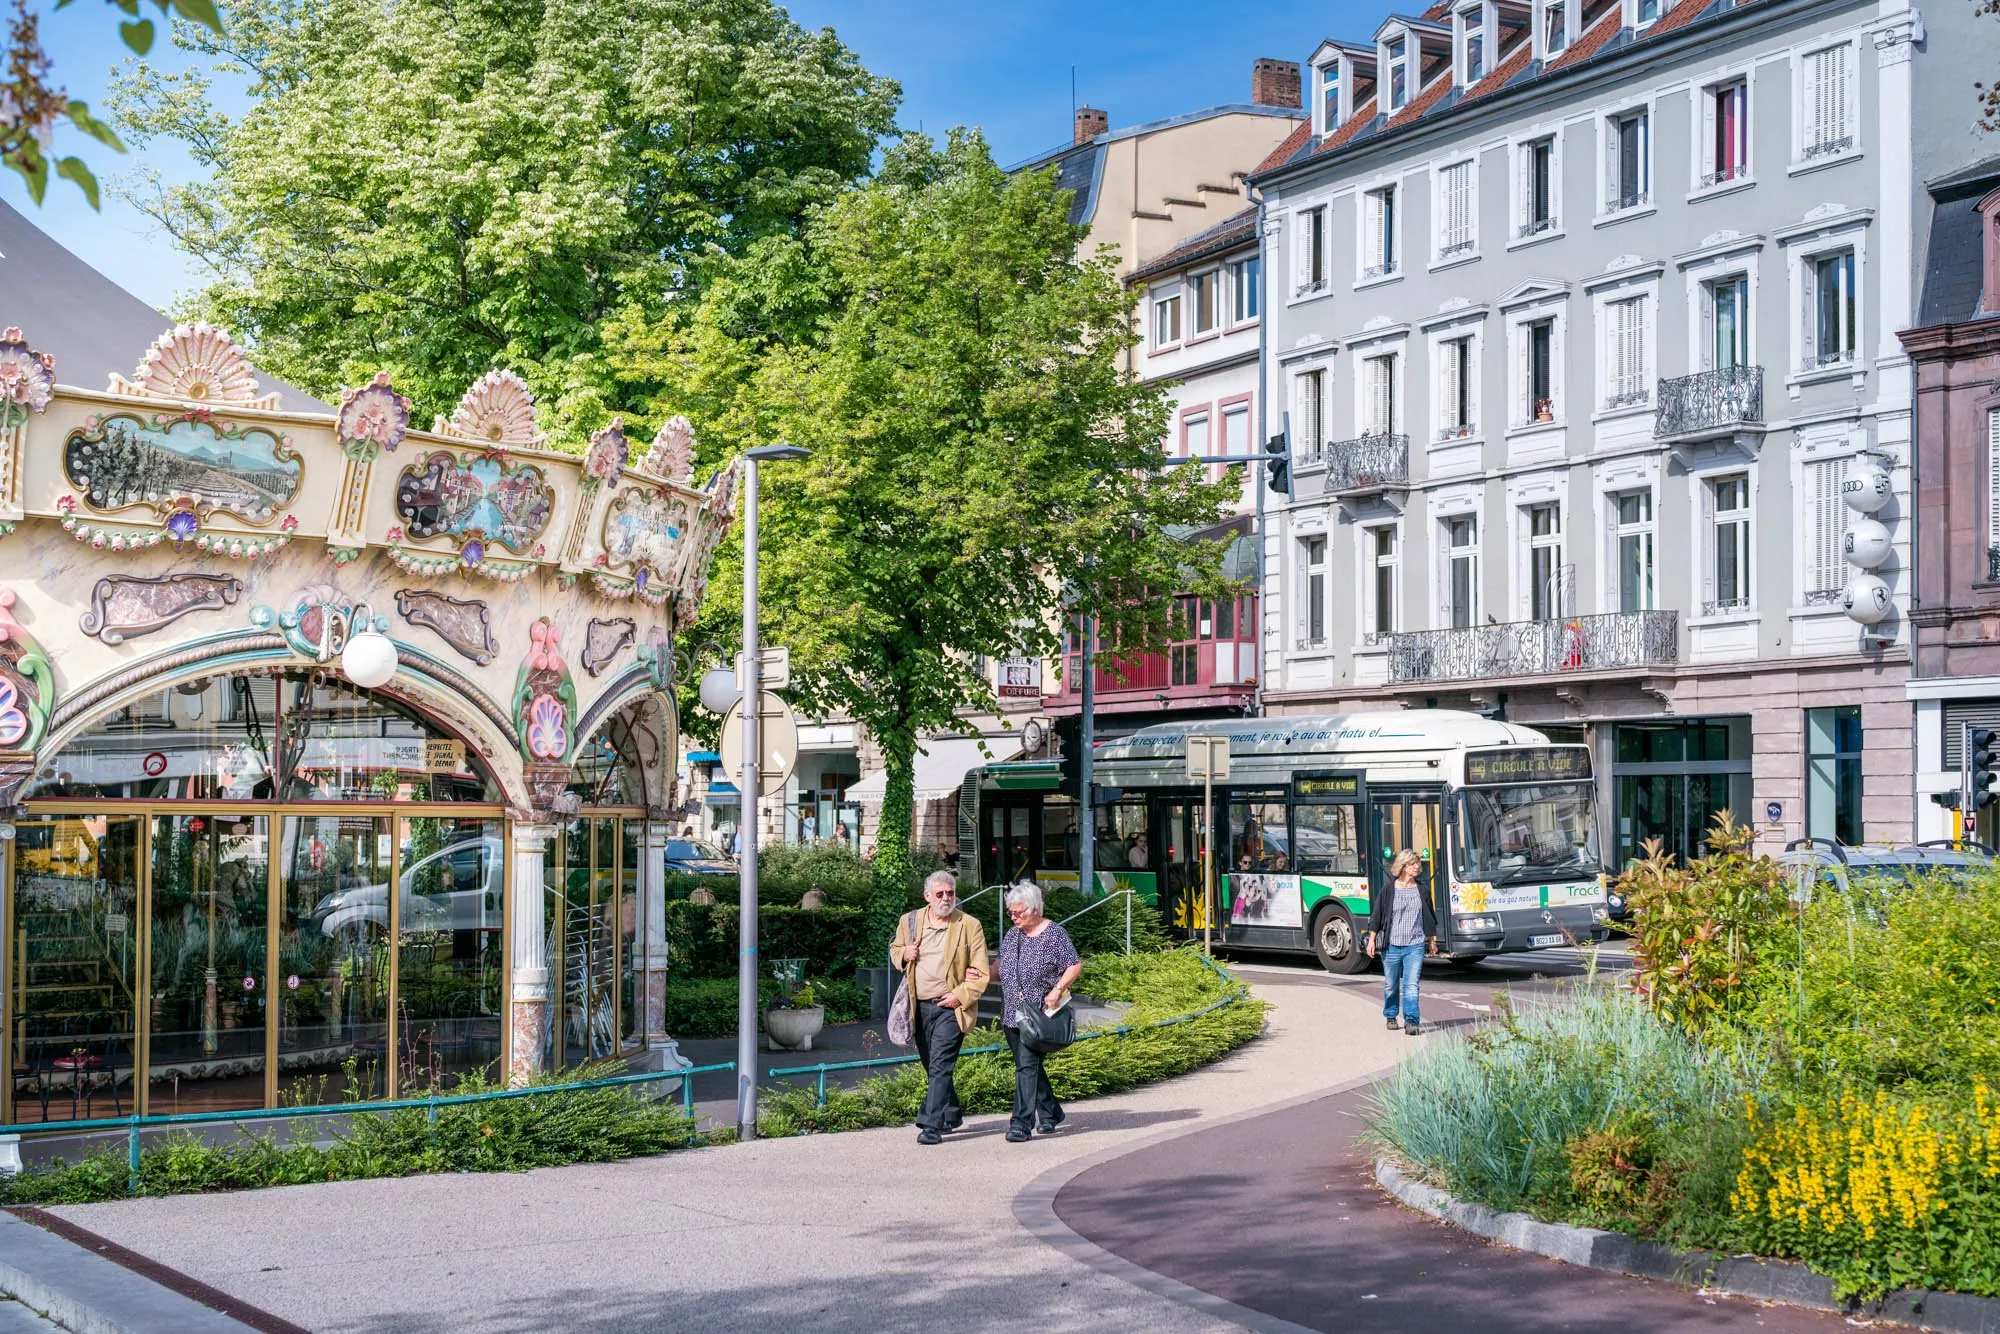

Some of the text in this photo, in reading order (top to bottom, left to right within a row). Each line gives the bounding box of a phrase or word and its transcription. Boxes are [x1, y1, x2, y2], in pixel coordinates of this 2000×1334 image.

[433, 751, 454, 759] SIGNAL
[1491, 760, 1534, 774] CIRCULE
[1548, 758, 1573, 770] VIDE
[1565, 885, 1600, 897] Trace
